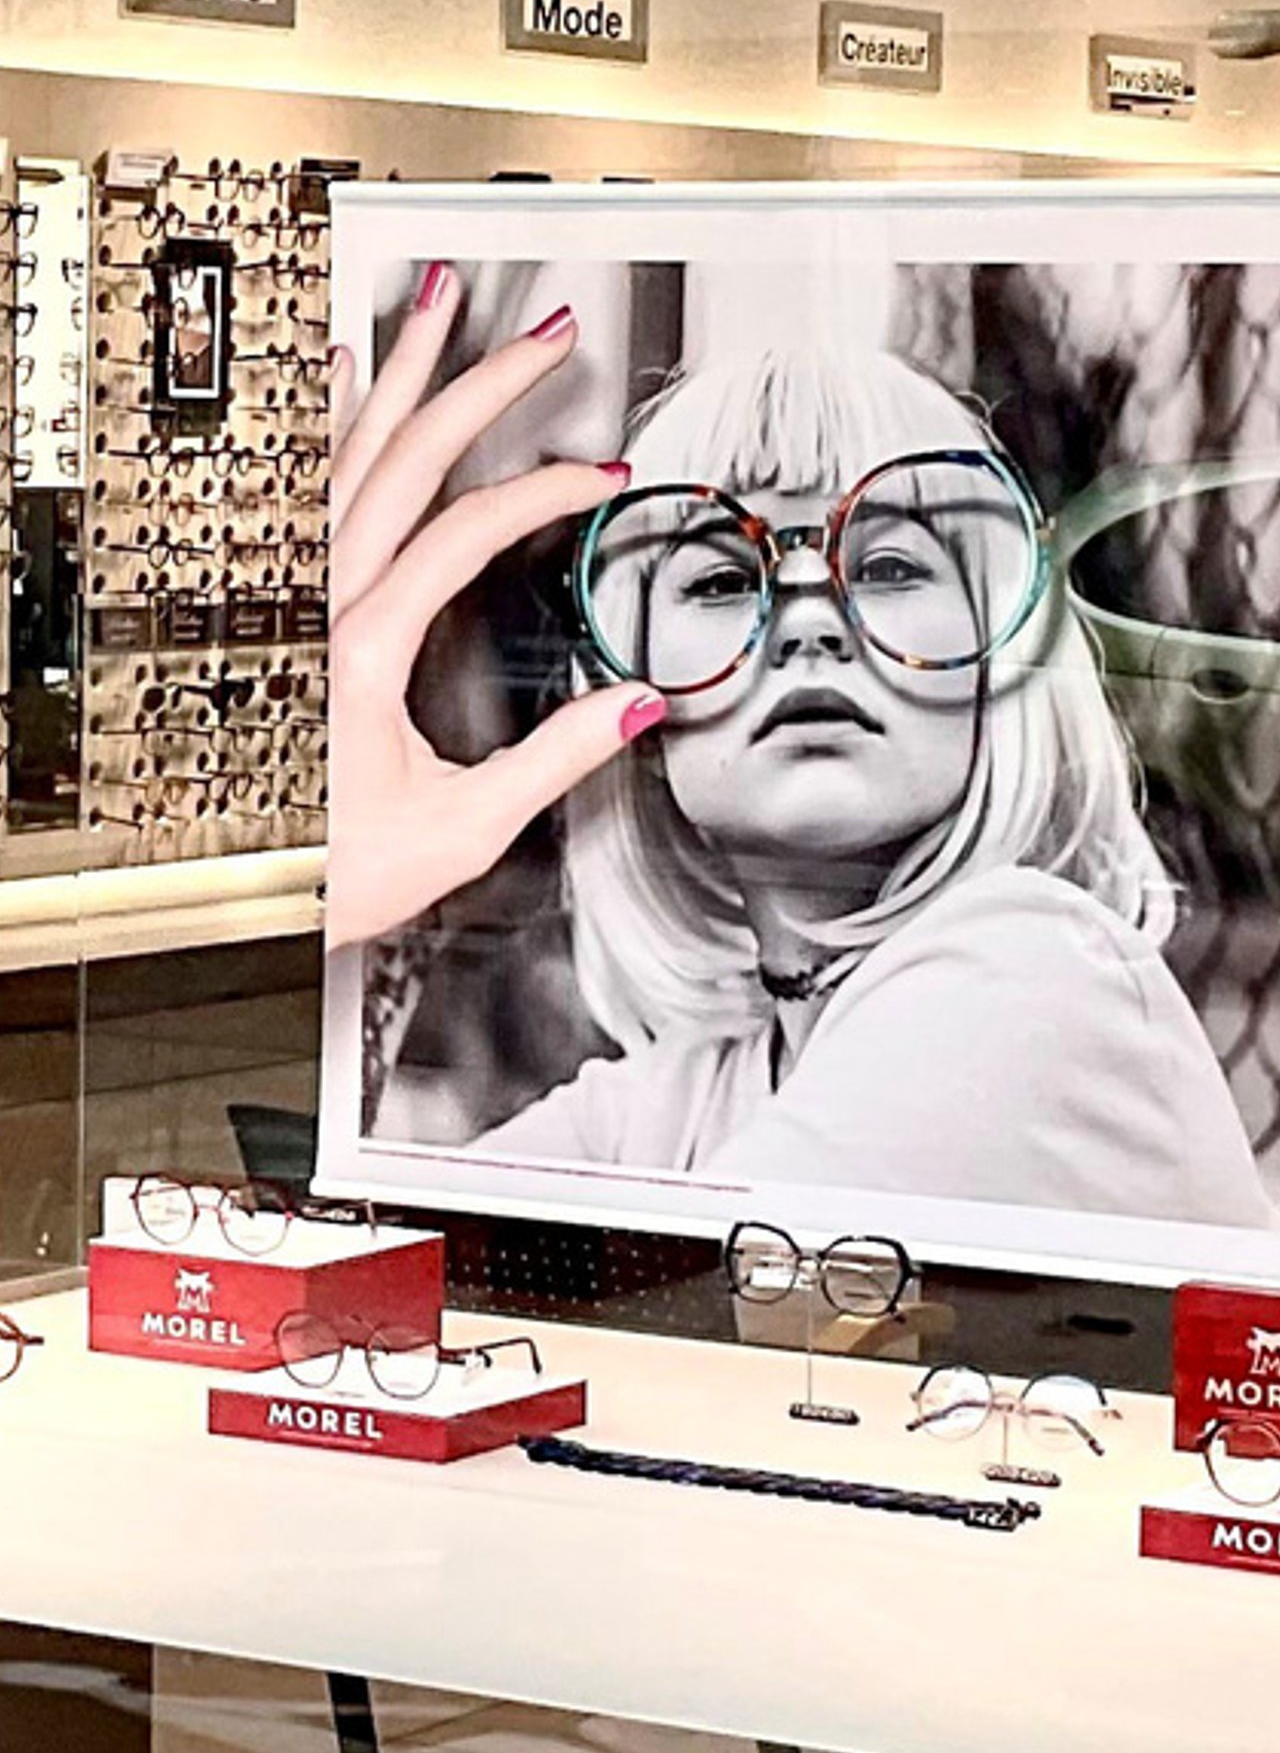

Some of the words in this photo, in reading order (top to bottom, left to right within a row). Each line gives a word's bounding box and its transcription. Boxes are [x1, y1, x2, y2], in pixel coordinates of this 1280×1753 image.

[841, 32, 926, 66] Créateur
[141, 1311, 248, 1346] MOREL
[268, 1402, 383, 1439] MOREL
